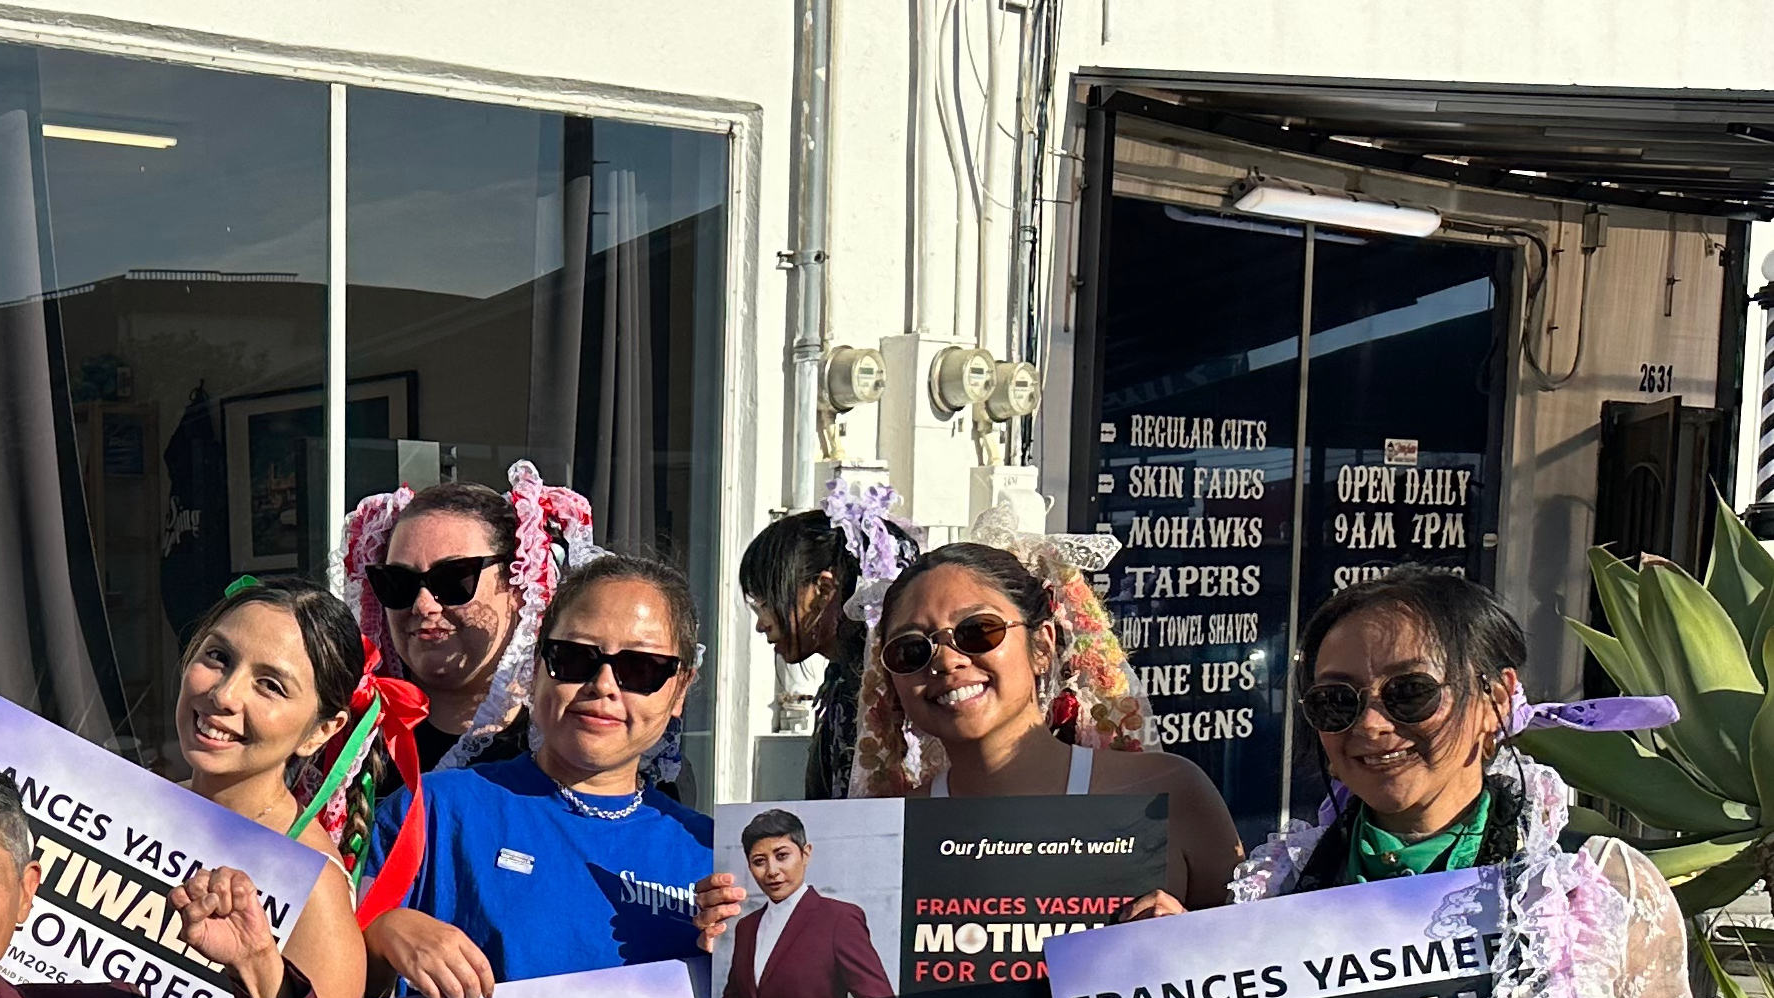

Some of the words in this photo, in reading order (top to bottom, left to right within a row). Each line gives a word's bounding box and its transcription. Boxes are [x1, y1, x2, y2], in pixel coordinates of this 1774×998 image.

[1639, 363, 1673, 393] 2631
[1130, 414, 1214, 448] REGULAR
[1221, 419, 1267, 450] CUTS
[1129, 465, 1185, 498] SKIN
[1193, 467, 1265, 499] FADES
[1338, 464, 1397, 503] OPEN
[1404, 468, 1471, 506] DAILY
[1127, 516, 1263, 548] MOHAWKS
[1334, 512, 1397, 549] 9AM
[1411, 512, 1467, 549] 7PM
[1125, 565, 1260, 598] TAPERS
[1122, 615, 1153, 649] HOT
[1157, 615, 1204, 647] TOWEL
[1208, 613, 1258, 644] SHAVES
[1136, 664, 1191, 696] INE
[1202, 661, 1256, 692] UPS
[1143, 707, 1254, 746] ESIGNS
[940, 840, 975, 855] Our
[975, 838, 1033, 859] future
[1037, 838, 1083, 854] can't
[1086, 837, 1135, 854] wait!
[915, 898, 1026, 915] FRANCES
[1035, 897, 1135, 915] YASME
[914, 922, 1105, 954] MOTIW
[915, 961, 976, 982] FOR
